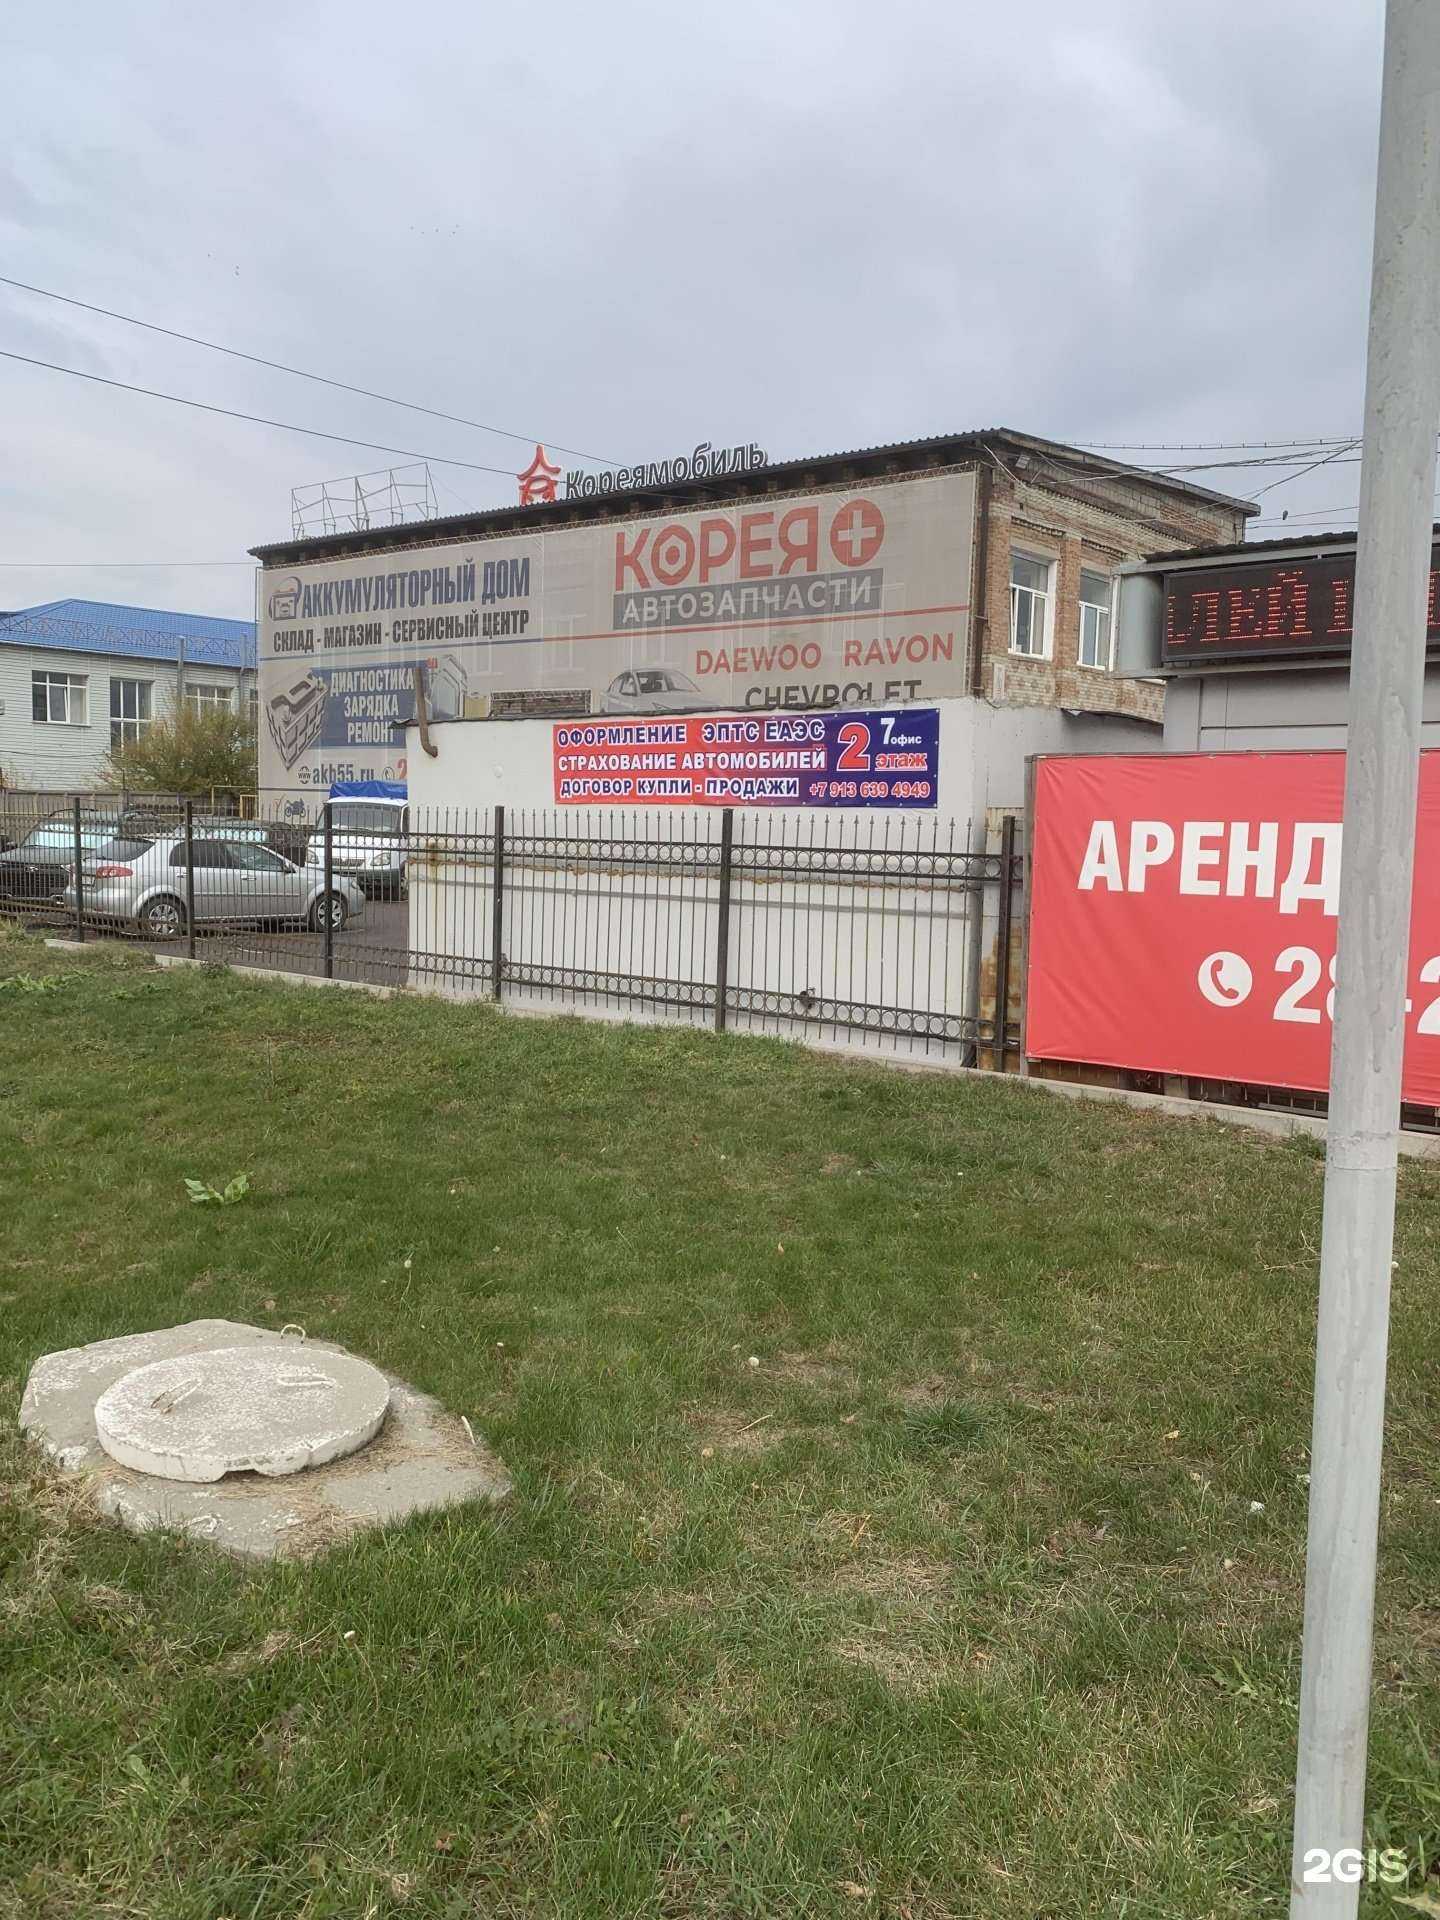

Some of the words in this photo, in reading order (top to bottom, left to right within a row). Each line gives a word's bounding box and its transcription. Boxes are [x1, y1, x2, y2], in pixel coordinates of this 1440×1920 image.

[565, 441, 768, 500] Кореямобиль
[615, 505, 819, 591] КОРЕЯ
[301, 558, 476, 618] АККУМУЛЯТОРНЫЙ
[482, 557, 530, 605] ДОМ
[621, 575, 872, 624] АВТОЗАПЧАСТИ
[273, 629, 315, 653] СКЛАД
[323, 622, 382, 649] МАГАЗИН
[392, 609, 479, 643] СЕРВИСНЫЙ
[482, 609, 529, 639] ЦЕНТР
[696, 643, 822, 675] DAEWOO
[844, 632, 954, 667] RAVON
[330, 668, 414, 697] ДИАГНОСТИКА
[344, 694, 399, 720] ЗАРЯДКА
[558, 725, 686, 746] ОФОРМЛЕНИЕ
[703, 721, 759, 743] ЭПТС
[765, 719, 825, 741] ЕАЭС
[836, 722, 870, 771] 2
[874, 752, 928, 769] этаж
[880, 717, 896, 745] 7
[890, 734, 922, 747] офис
[558, 753, 677, 771] СТРАХОВАНИЕ
[681, 747, 826, 769] АВТОМОБИЛЕЙ
[560, 779, 633, 799] ДОГОВОР
[637, 778, 693, 796] КУПЛИ
[705, 777, 800, 799] ПРОДАЖИ
[809, 781, 828, 798] +7
[829, 781, 857, 798] 913
[860, 781, 888, 798] 639
[891, 781, 931, 798] 4949
[1077, 820, 1344, 916] АРЕНД
